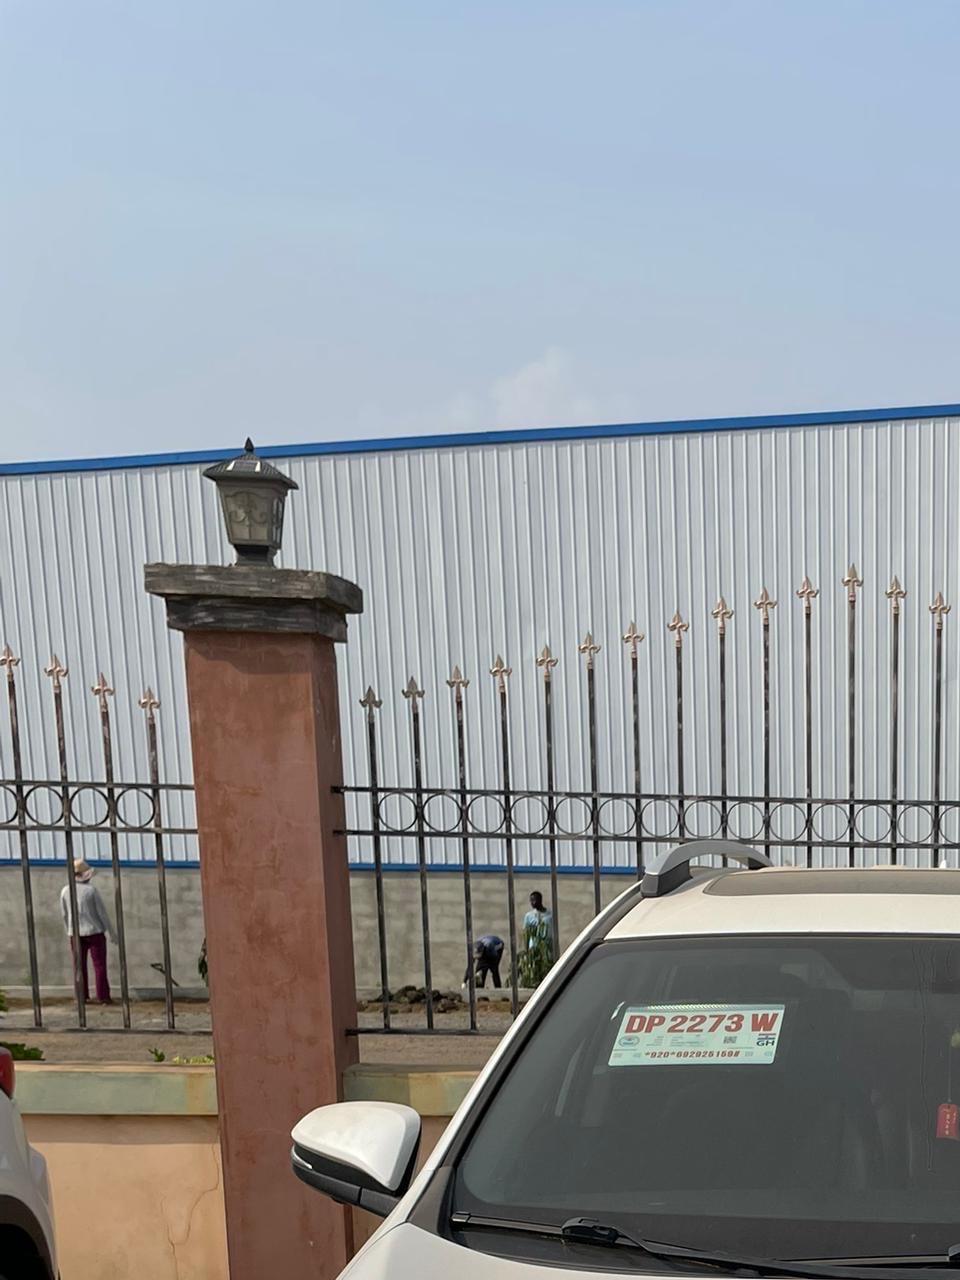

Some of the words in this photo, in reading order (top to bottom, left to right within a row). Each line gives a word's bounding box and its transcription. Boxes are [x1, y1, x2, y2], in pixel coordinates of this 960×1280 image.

[625, 1015, 666, 1033] DP
[667, 1014, 745, 1033] 2273
[751, 1013, 778, 1032] W
